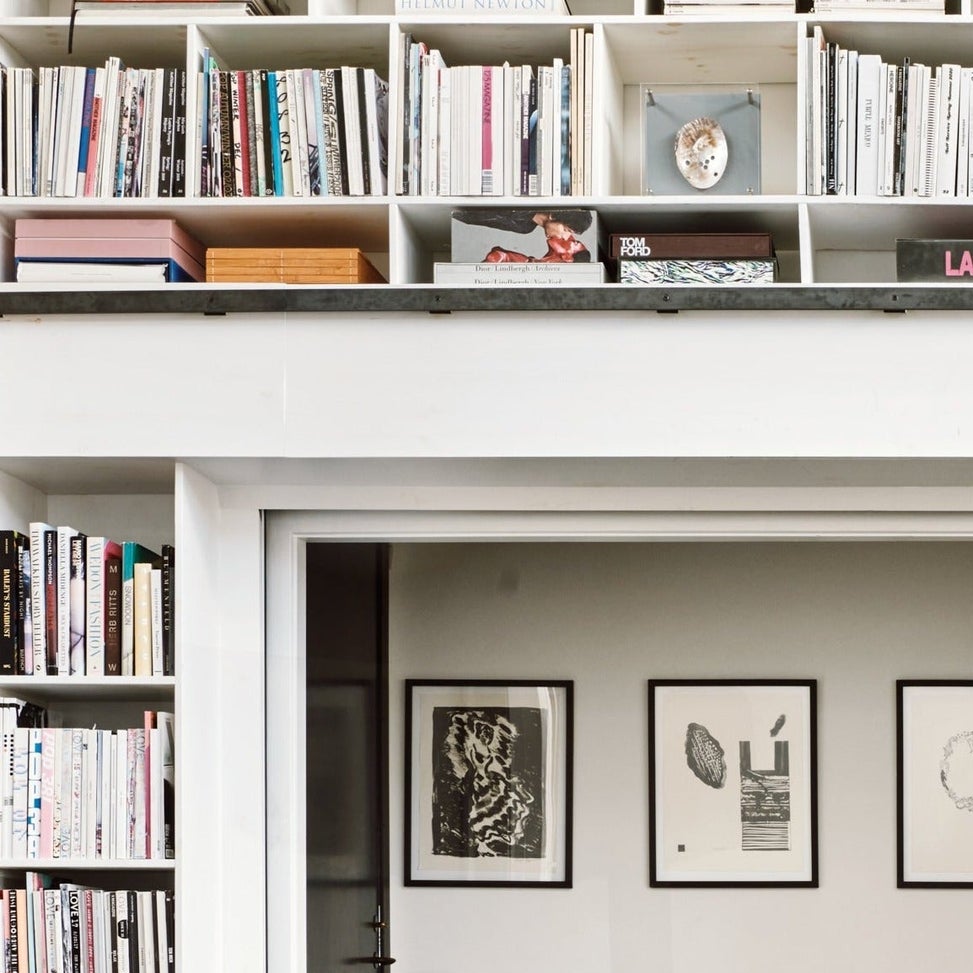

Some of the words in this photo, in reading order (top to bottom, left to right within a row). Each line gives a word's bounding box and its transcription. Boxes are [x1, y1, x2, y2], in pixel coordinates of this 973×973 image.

[620, 237, 646, 247] TOM
[620, 246, 650, 256] FORD
[70, 891, 78, 917] LOVE
